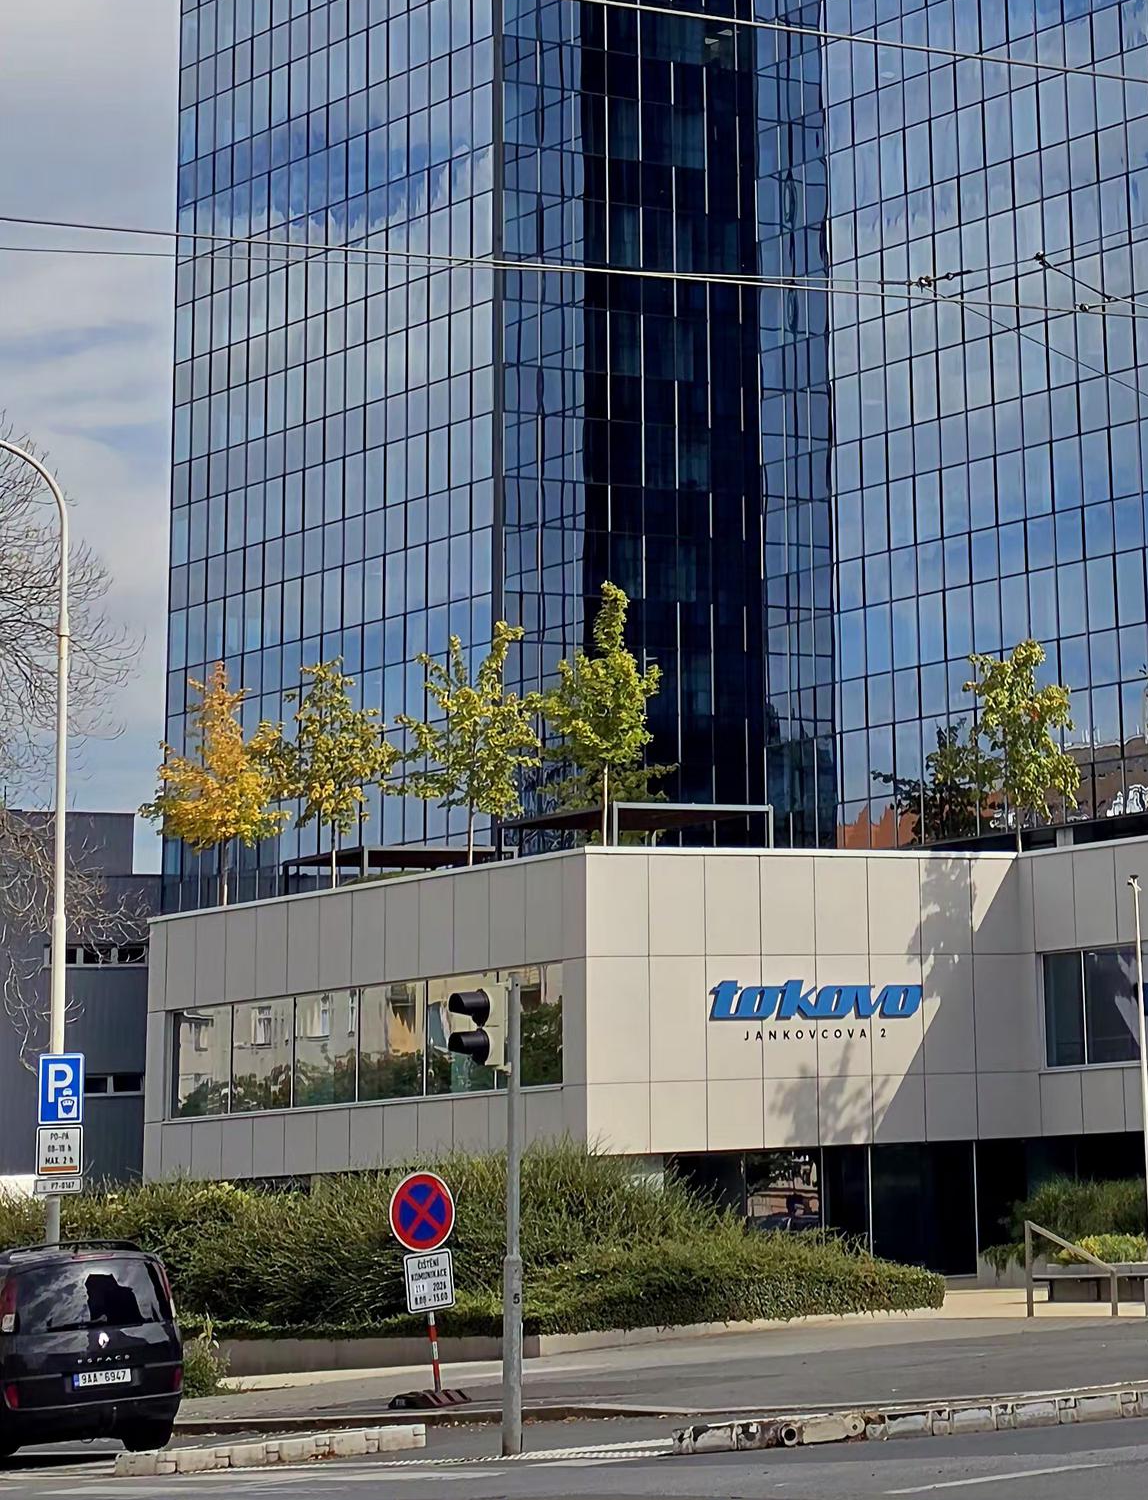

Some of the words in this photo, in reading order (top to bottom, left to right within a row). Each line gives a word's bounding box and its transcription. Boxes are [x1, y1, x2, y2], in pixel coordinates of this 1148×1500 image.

[709, 979, 923, 1022] tokovo
[744, 1028, 867, 1041] JANKOVCOVA
[880, 1028, 887, 1038] 2
[48, 1063, 73, 1103] P
[512, 1293, 520, 1304] 5
[81, 1373, 98, 1385] 9AA
[104, 1370, 126, 1382] 6947
